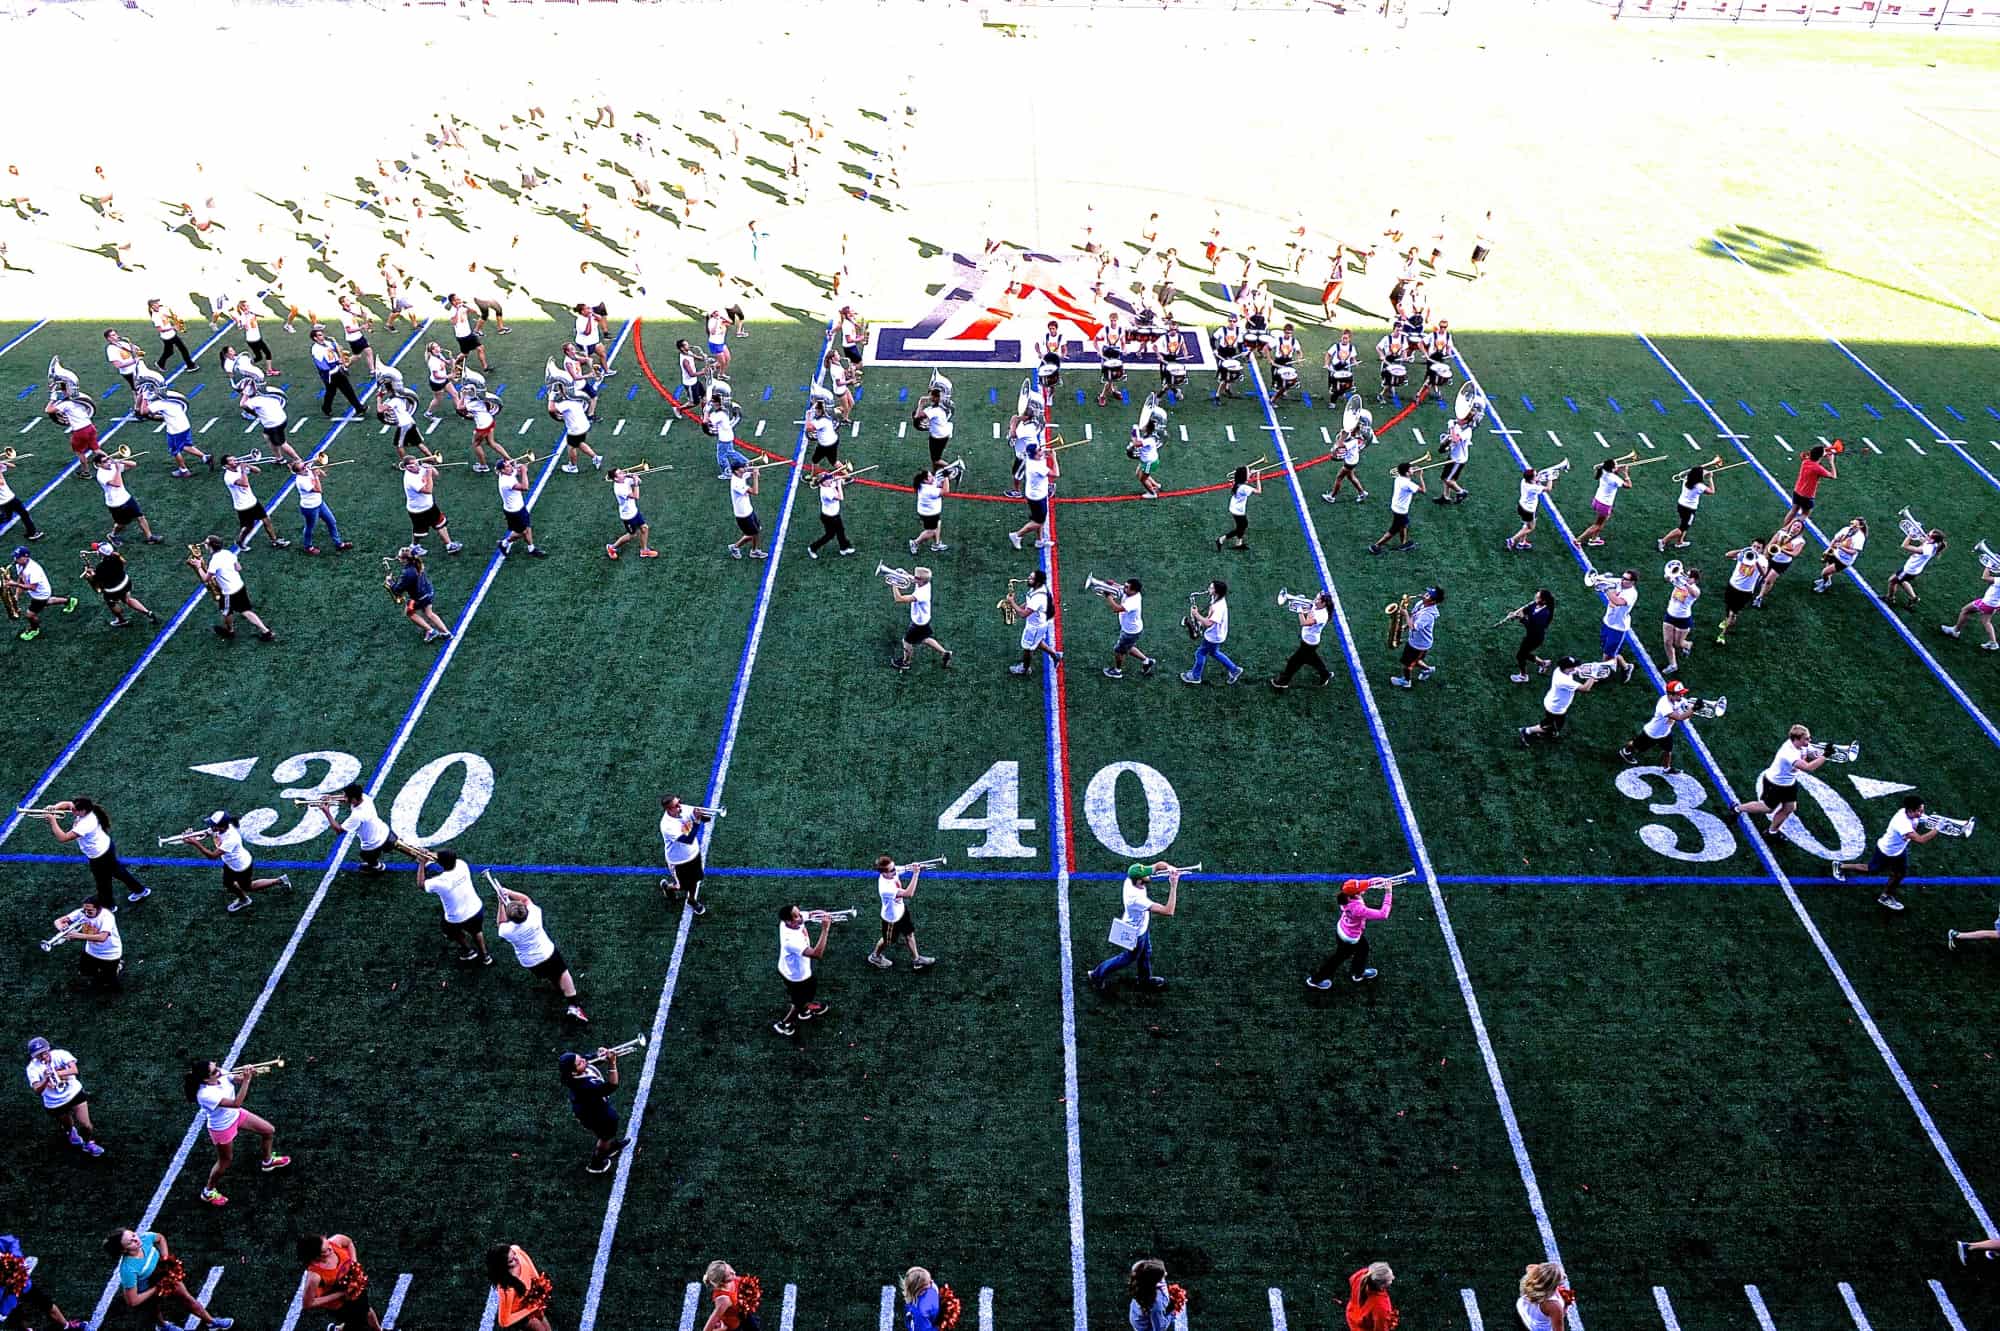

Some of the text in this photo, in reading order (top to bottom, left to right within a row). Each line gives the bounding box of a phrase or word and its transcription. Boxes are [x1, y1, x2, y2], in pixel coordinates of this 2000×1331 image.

[239, 751, 494, 847] 30
[938, 761, 1181, 857] 40
[1615, 766, 1866, 861] 30
